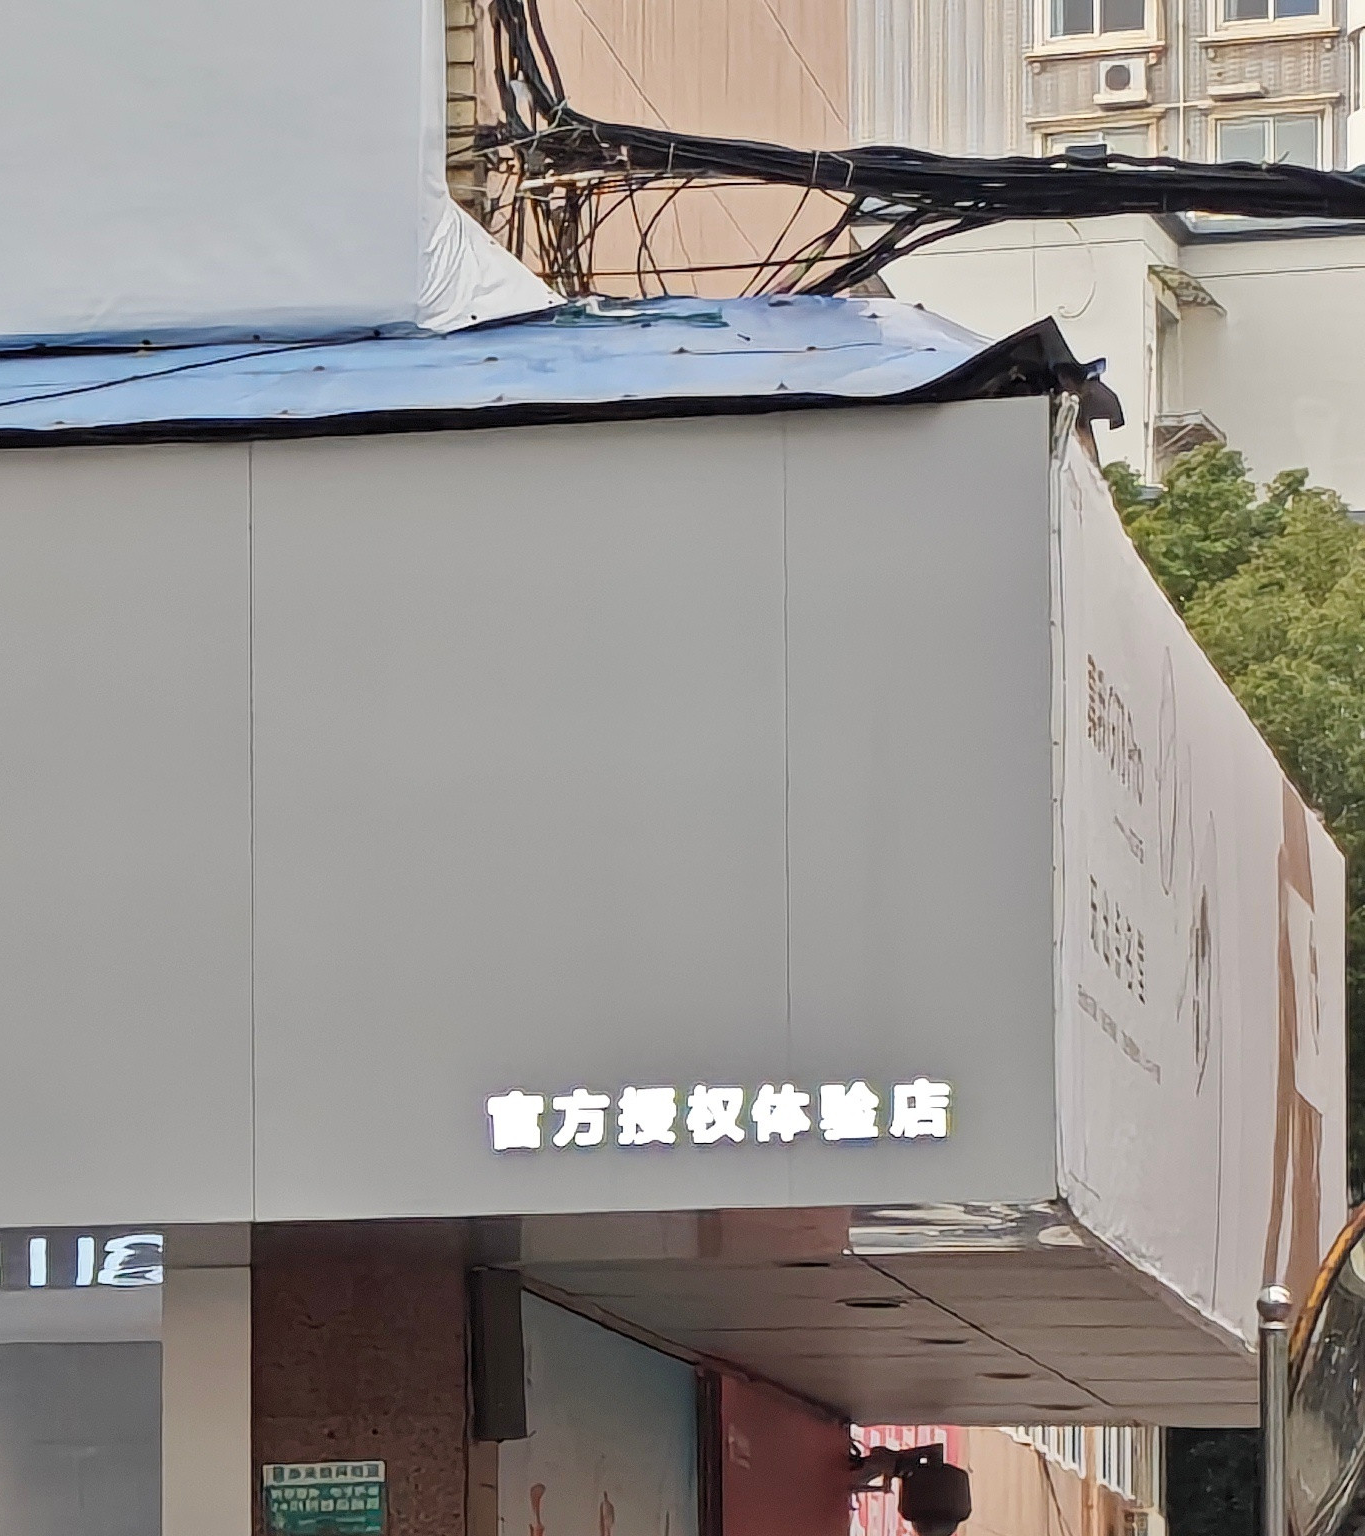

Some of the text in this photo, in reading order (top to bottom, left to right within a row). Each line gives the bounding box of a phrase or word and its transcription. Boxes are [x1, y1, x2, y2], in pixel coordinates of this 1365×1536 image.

[486, 1077, 952, 1151] 官方授权体验店
